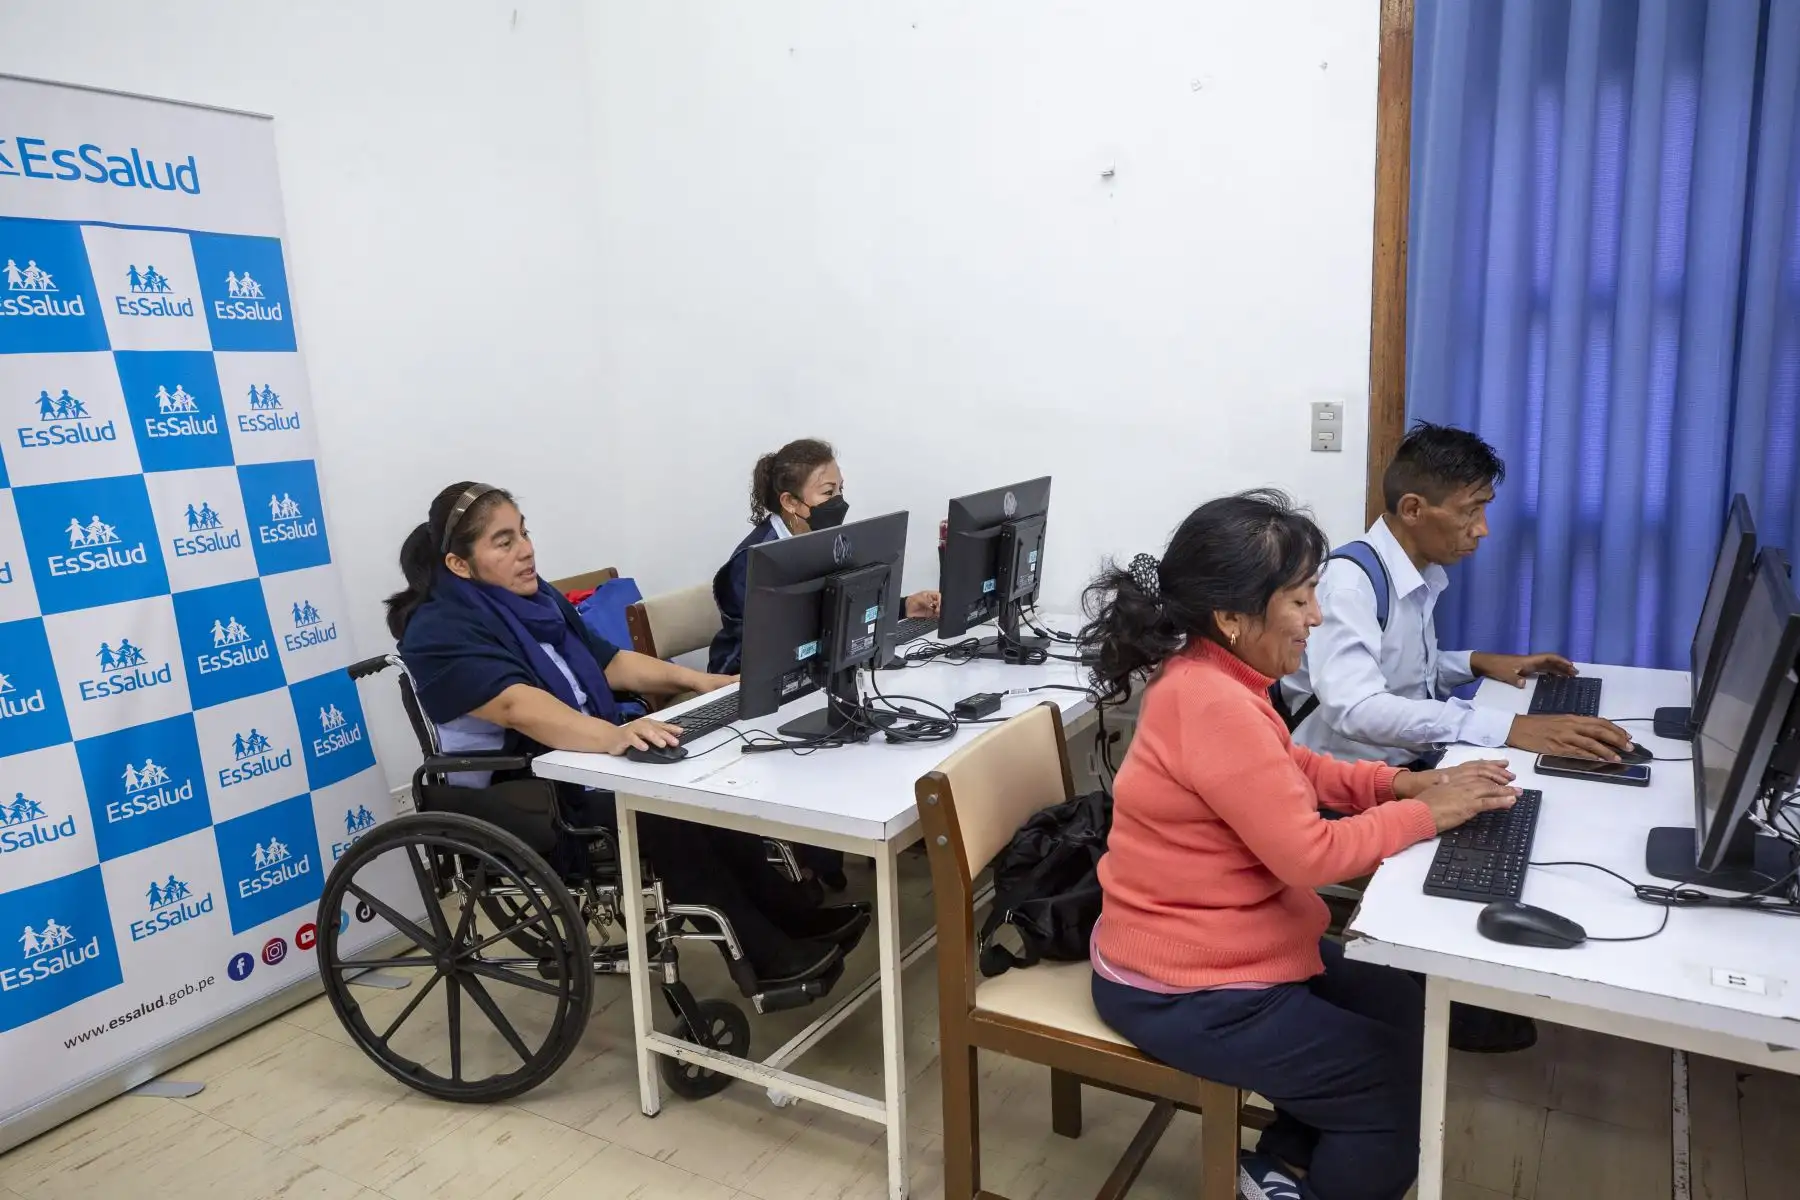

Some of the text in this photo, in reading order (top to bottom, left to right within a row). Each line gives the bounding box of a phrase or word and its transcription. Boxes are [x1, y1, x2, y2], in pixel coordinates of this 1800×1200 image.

[15, 136, 201, 195] EsSalud
[116, 295, 194, 317] EsSalud
[215, 300, 283, 321] EsSalud
[17, 420, 117, 449] EsSalud
[145, 414, 218, 438] EsSalud
[237, 411, 301, 433] EsSalud
[173, 529, 242, 557] EsSalud
[259, 518, 318, 544] EsSalud
[47, 542, 147, 577] EsSalud
[283, 622, 338, 652] EsSalud
[197, 639, 269, 675] EsSalud
[79, 662, 173, 702] EsSalud
[313, 723, 362, 758] EsSalud
[218, 748, 293, 788] EsSalud
[106, 779, 193, 824] EsSalud
[0, 814, 77, 854] Salud
[238, 854, 310, 899] EsSalud
[130, 891, 214, 943] EsSalud
[0, 936, 100, 992] EsSalud
[63, 976, 216, 1050] www.essalud.gob.pe
